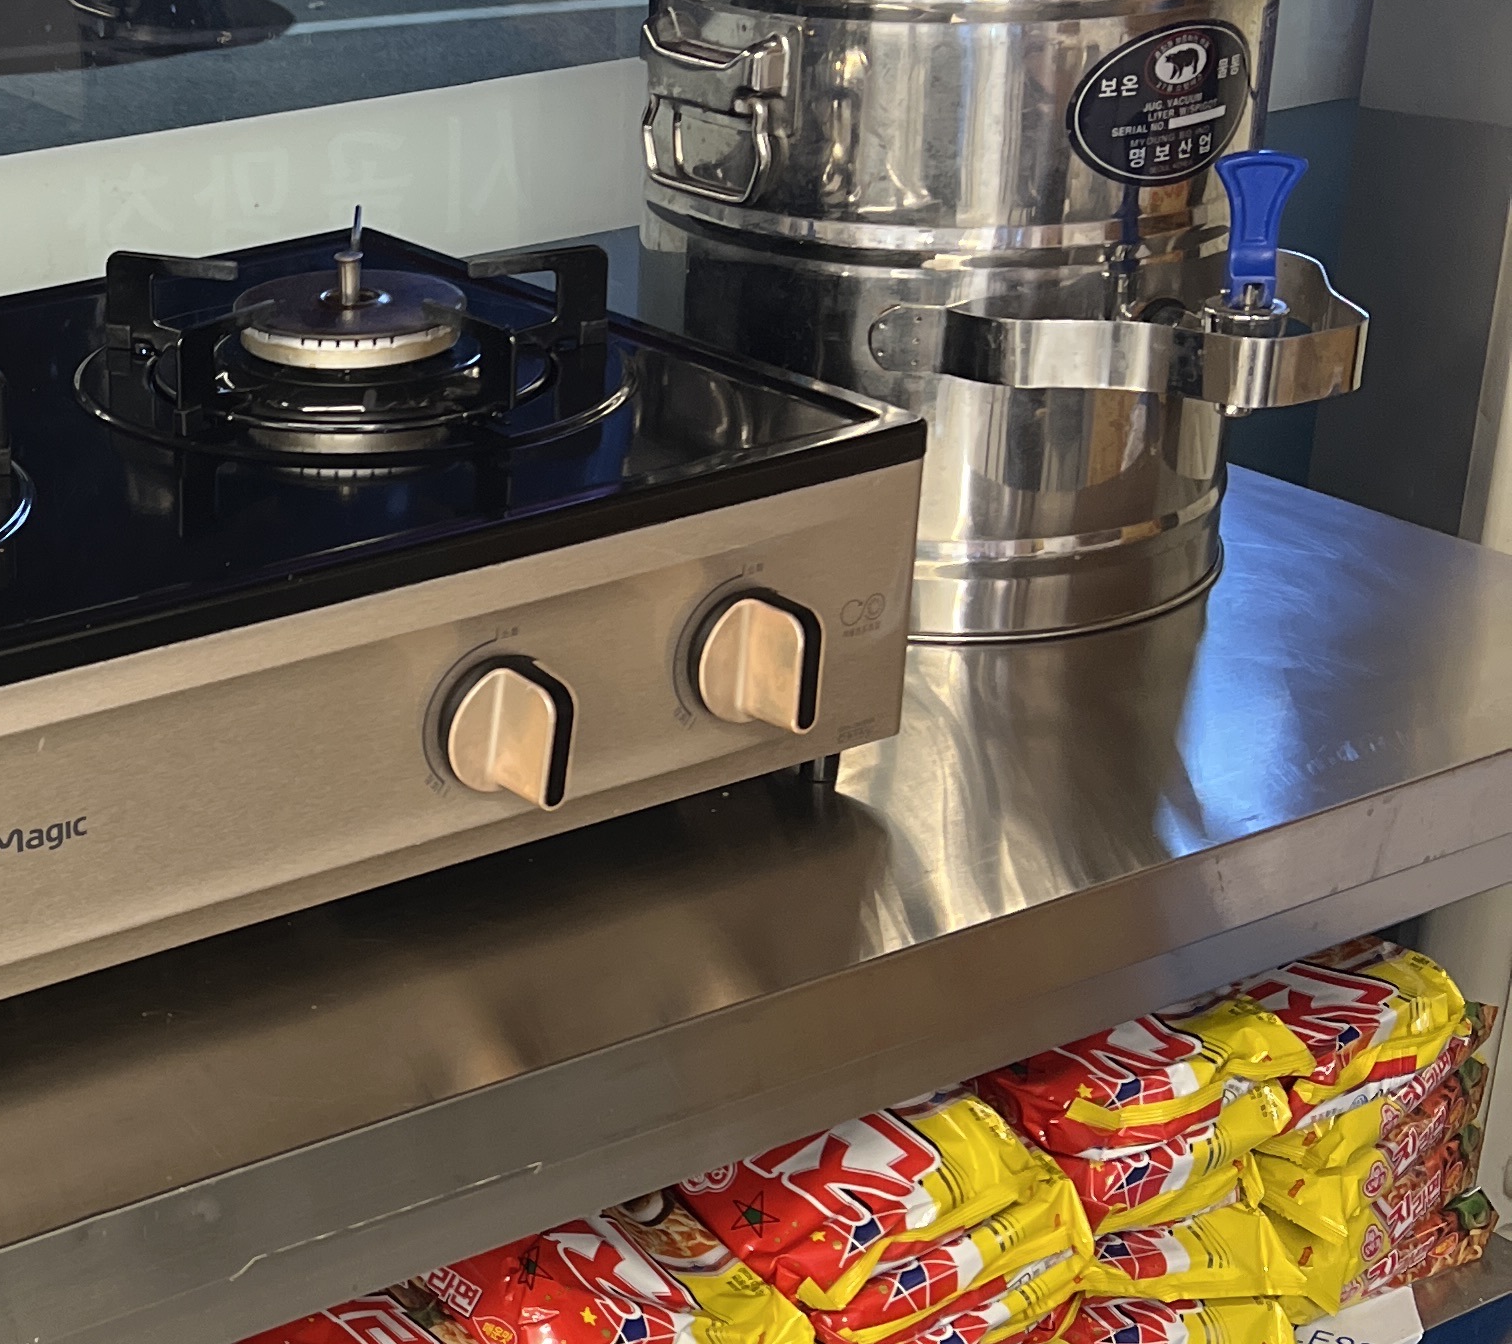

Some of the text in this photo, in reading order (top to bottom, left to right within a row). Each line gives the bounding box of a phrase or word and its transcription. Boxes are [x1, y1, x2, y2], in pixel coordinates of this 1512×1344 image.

[1098, 74, 1140, 98] 보온
[1111, 123, 1149, 138] SERIAL
[1128, 132, 1213, 169] 명보산업
